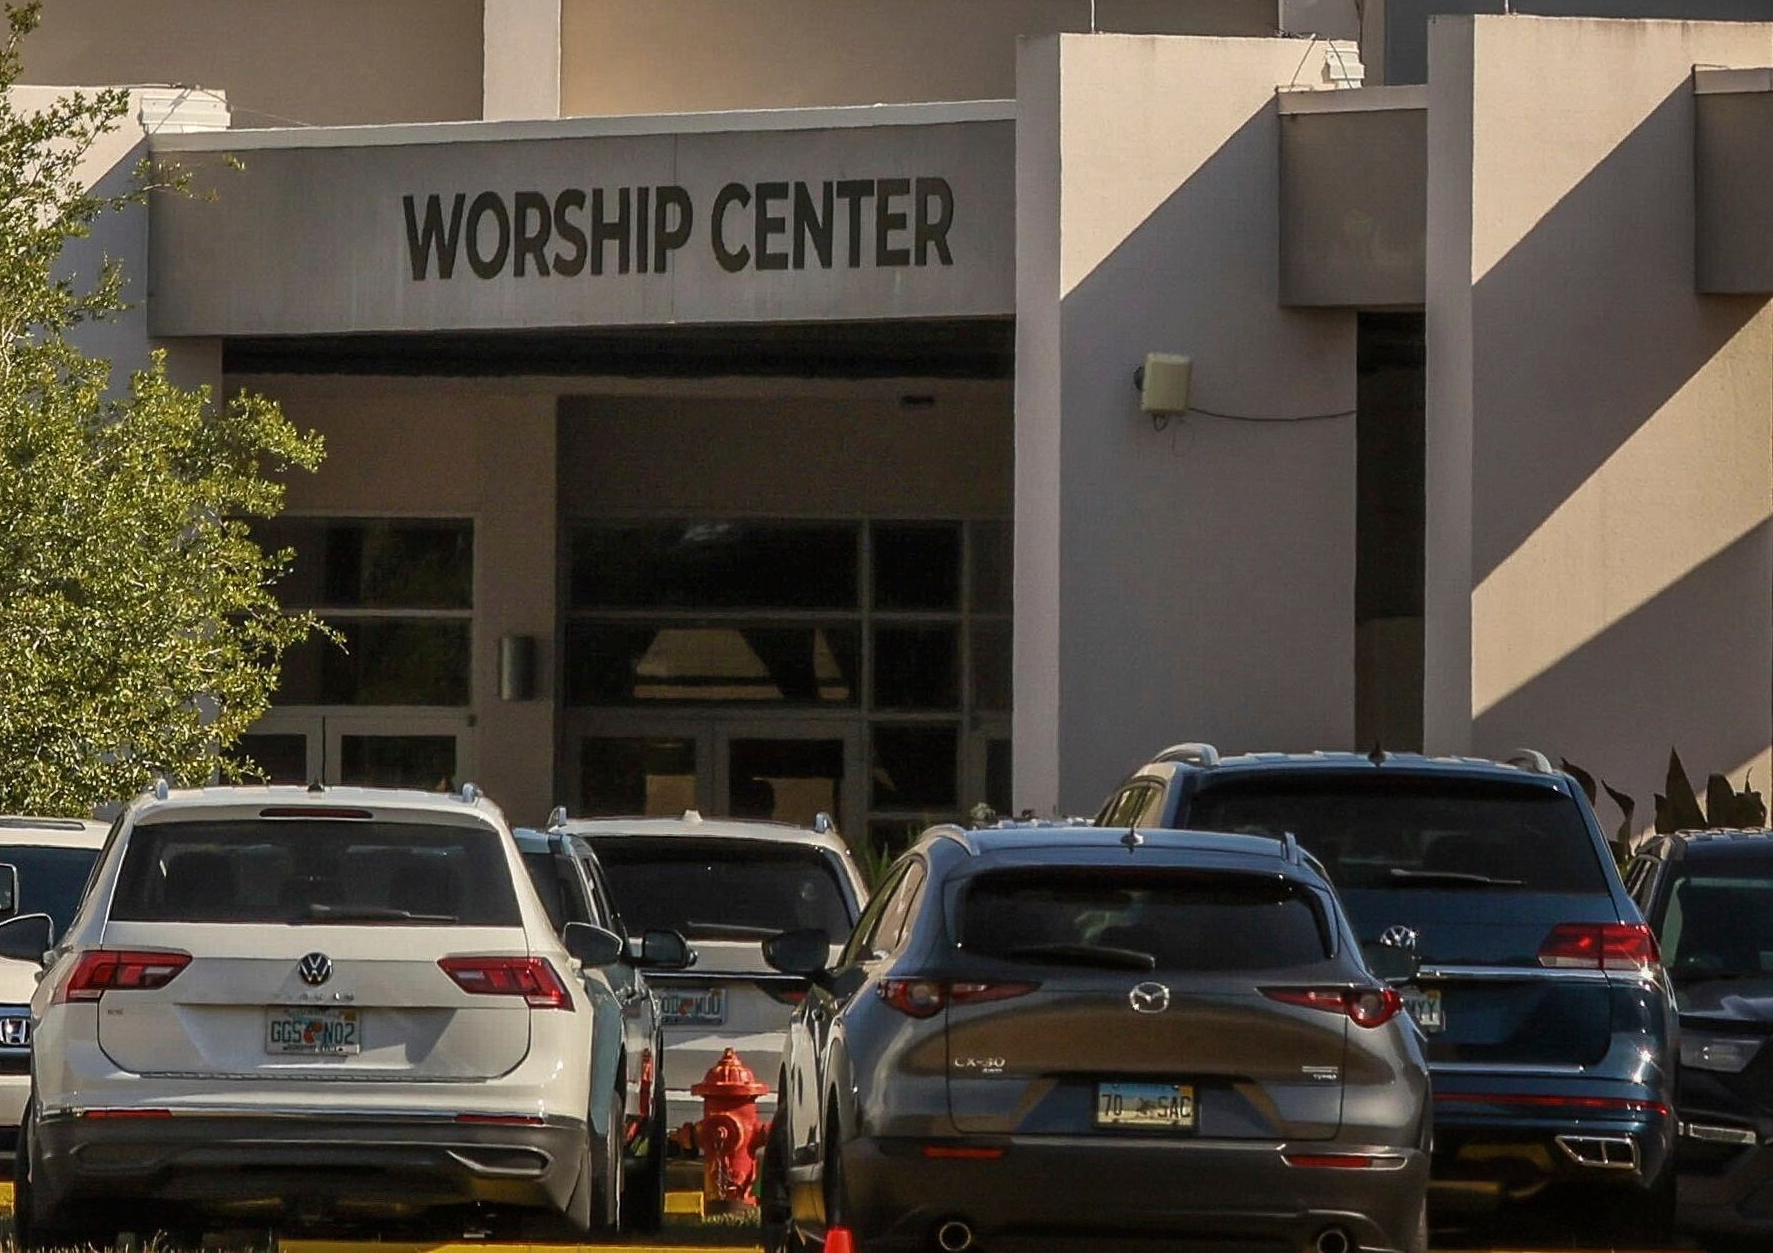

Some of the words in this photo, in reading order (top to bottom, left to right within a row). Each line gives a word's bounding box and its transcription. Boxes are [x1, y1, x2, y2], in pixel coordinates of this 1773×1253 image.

[402, 186, 693, 281] WORSHIP
[711, 177, 954, 273] CENTER
[1157, 1096, 1191, 1118] SAC
